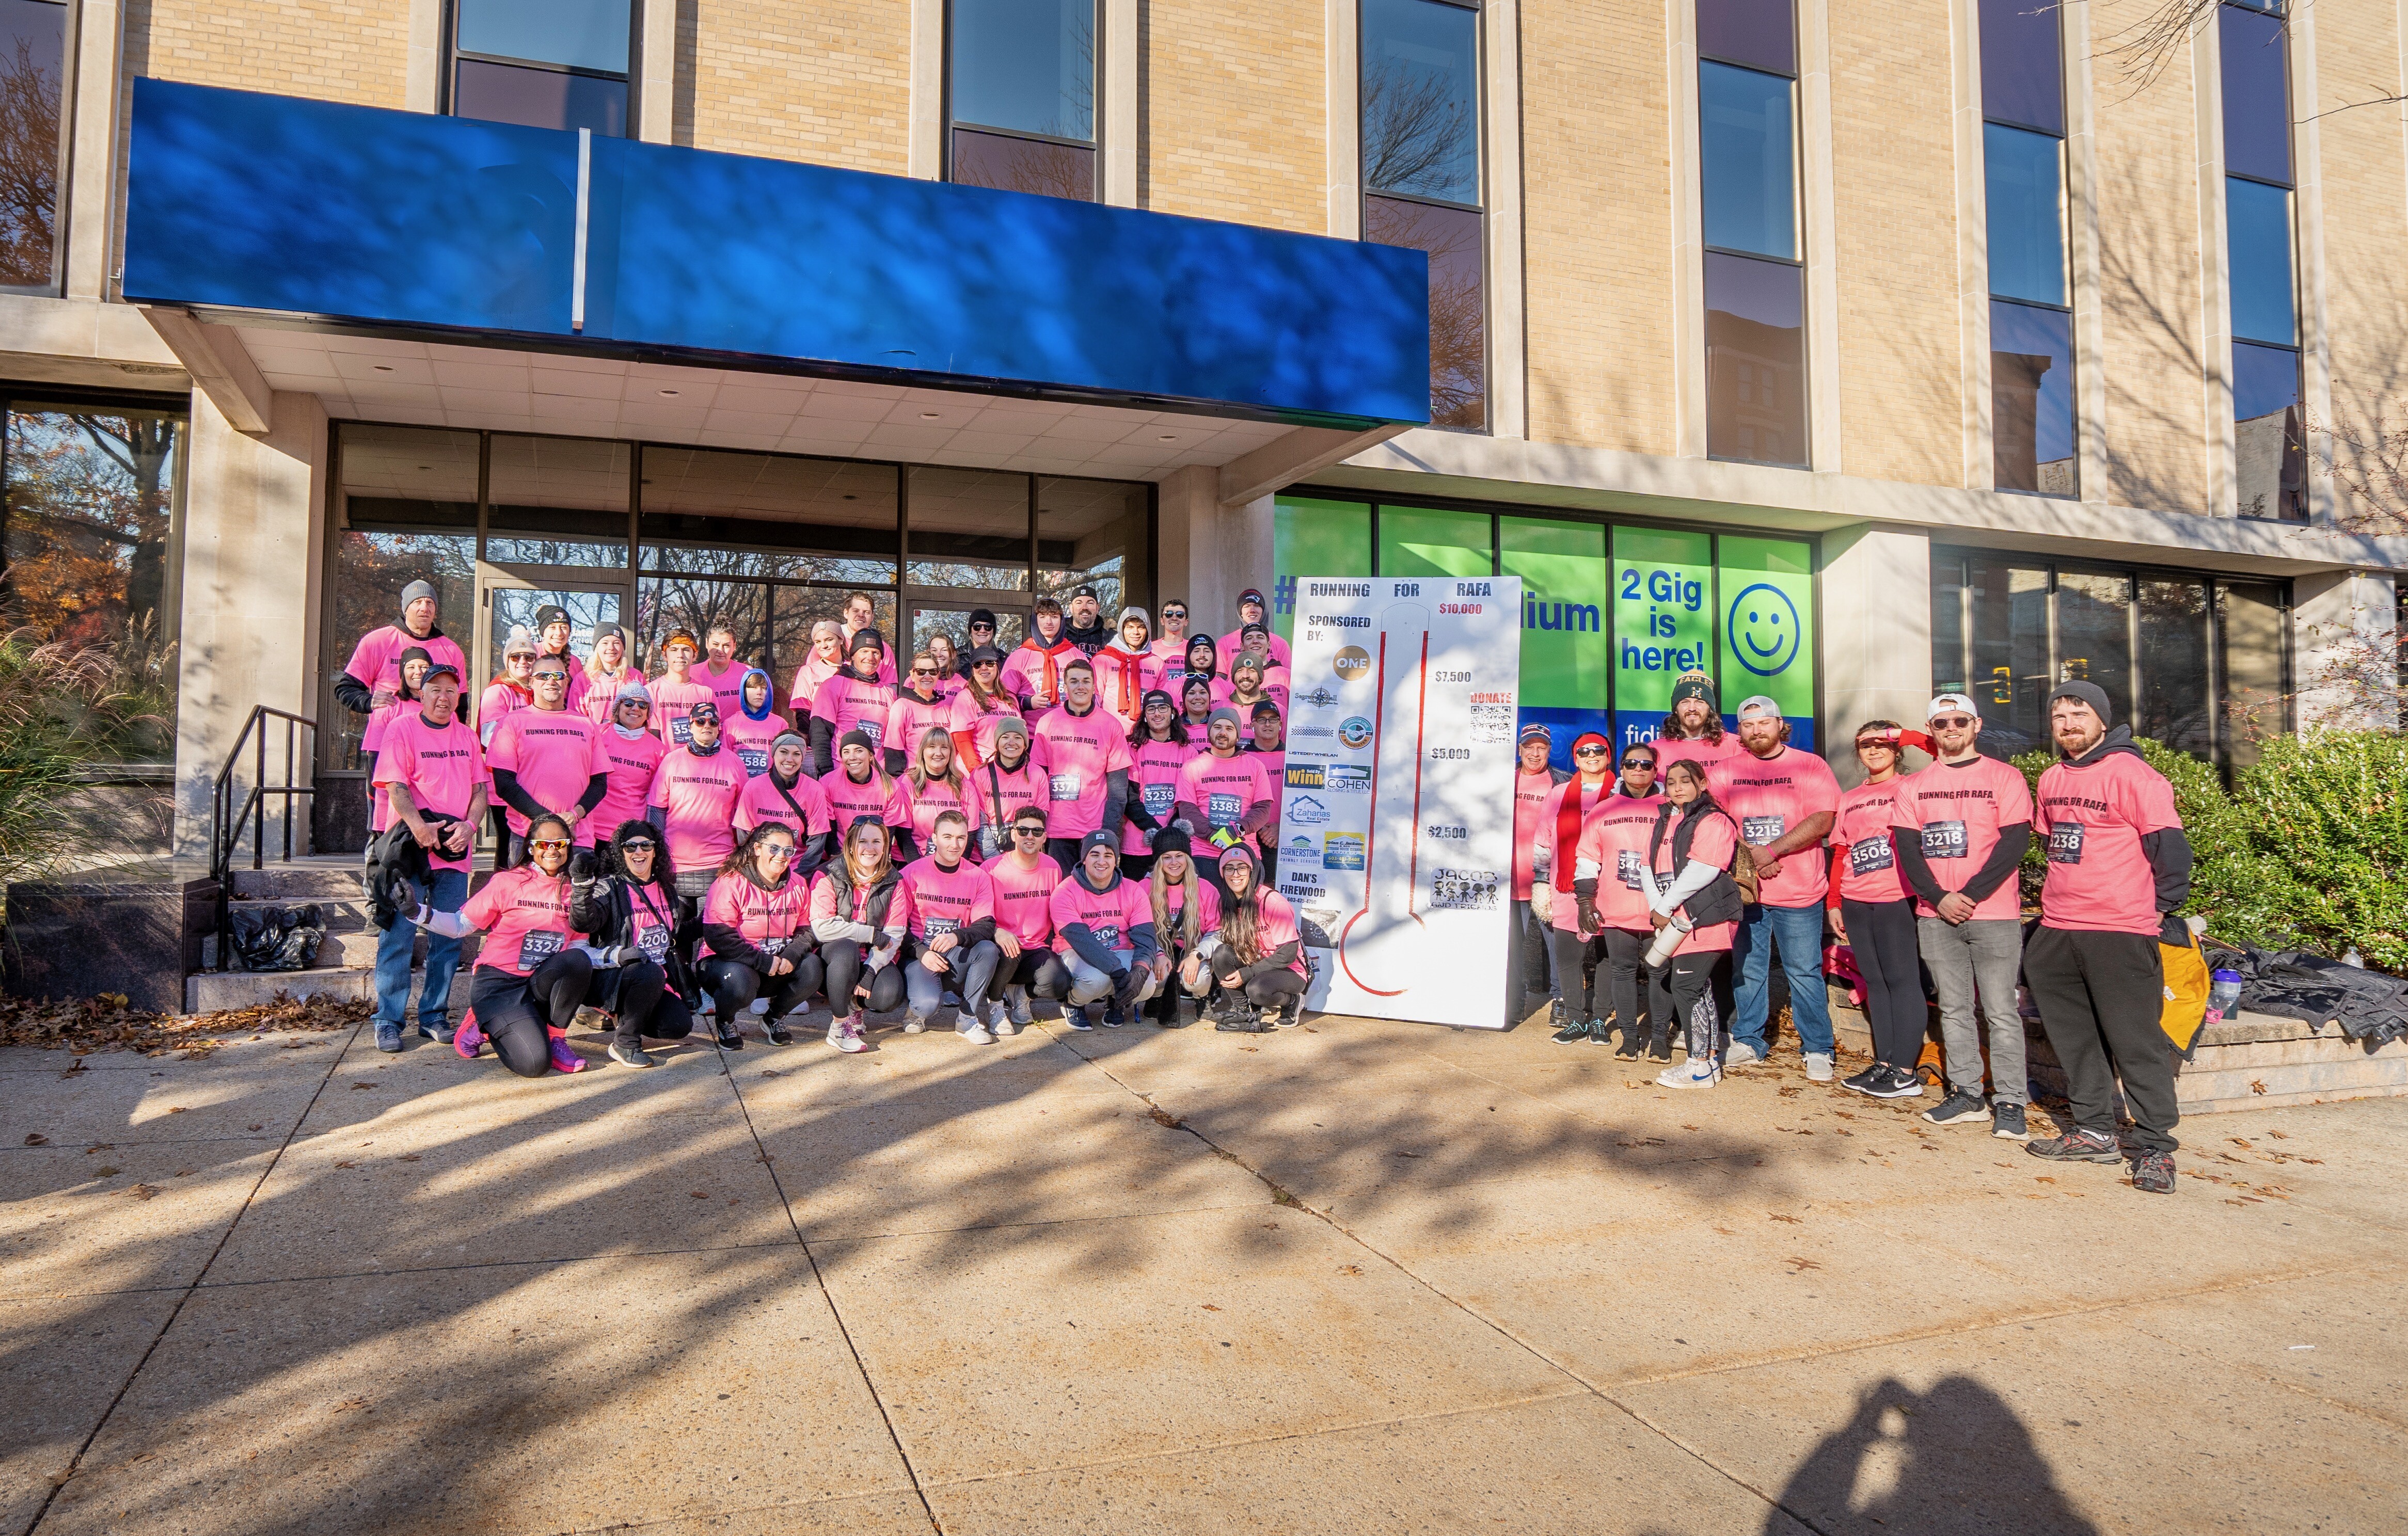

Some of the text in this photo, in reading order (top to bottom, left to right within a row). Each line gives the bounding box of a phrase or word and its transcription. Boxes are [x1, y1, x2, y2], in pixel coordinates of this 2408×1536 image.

[1310, 582, 1492, 597] RUNNING FOR RAFA
[1622, 569, 1701, 611] 2 Gig
[1439, 603, 1482, 615] $10,000
[1308, 615, 1371, 628] SPONSORED
[1650, 606, 1676, 638] is
[1307, 630, 1323, 641] BY:
[1622, 637, 1704, 673] here!
[1336, 658, 1368, 669] ONE
[1435, 670, 1471, 682] $7,500
[1679, 676, 1714, 689] EAGLES
[1470, 692, 1512, 703] DONATE
[1344, 718, 1362, 727] INVESTOR
[569, 729, 584, 738] RAFA
[1625, 724, 1660, 746] fidi
[1432, 748, 1470, 760] $5,000
[715, 778, 729, 787] RAFA
[1201, 776, 1225, 784] RUNNING
[1288, 769, 1324, 785] Winn
[1761, 778, 1773, 787] FOR
[1052, 782, 1078, 792] 3371
[1327, 779, 1371, 790] COHEN
[1146, 791, 1175, 801] 3239
[1918, 792, 1955, 801] RUNNING
[1971, 790, 1993, 798] RAFA
[1211, 801, 1240, 813] 3383
[2083, 798, 2108, 812] RAFA
[757, 807, 784, 818] RUNNING
[1296, 808, 1330, 818] Zaharias
[1604, 817, 1634, 827] RUNNING
[1428, 826, 1466, 839] $2,500
[1746, 825, 1781, 838] 3215
[1926, 831, 1963, 847] 3218
[1857, 840, 1879, 851] MARATHON
[1281, 847, 1321, 857] CORNERSTONE
[1853, 844, 1891, 864] 3506
[1291, 872, 1317, 884] DAN'S
[1004, 891, 1028, 900] RUNNING
[1280, 884, 1326, 898] FIREWOOD
[517, 899, 550, 910] RUNNING
[916, 893, 943, 902] RUNNING
[957, 898, 971, 906] RAFA
[1081, 911, 1101, 919] UNNING
[524, 938, 561, 953] 3324
